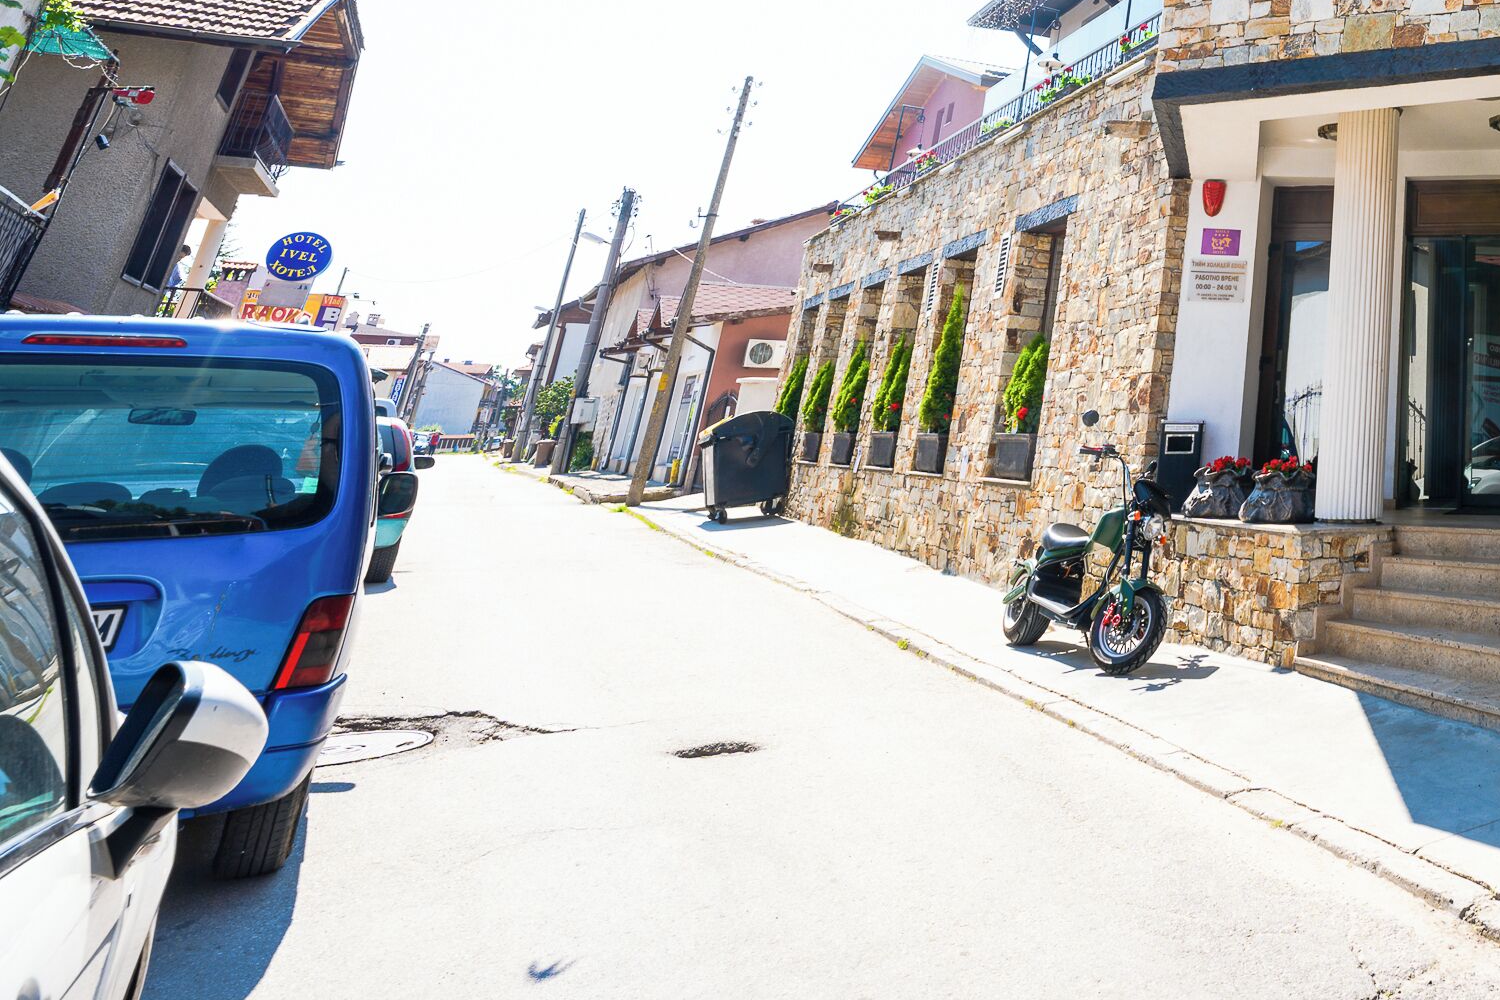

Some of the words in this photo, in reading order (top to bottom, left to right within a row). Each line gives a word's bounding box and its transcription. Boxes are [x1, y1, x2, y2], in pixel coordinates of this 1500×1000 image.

[282, 234, 328, 253] HOTEL
[280, 248, 317, 262] IVEL
[269, 260, 317, 278] ХОТЕЛ
